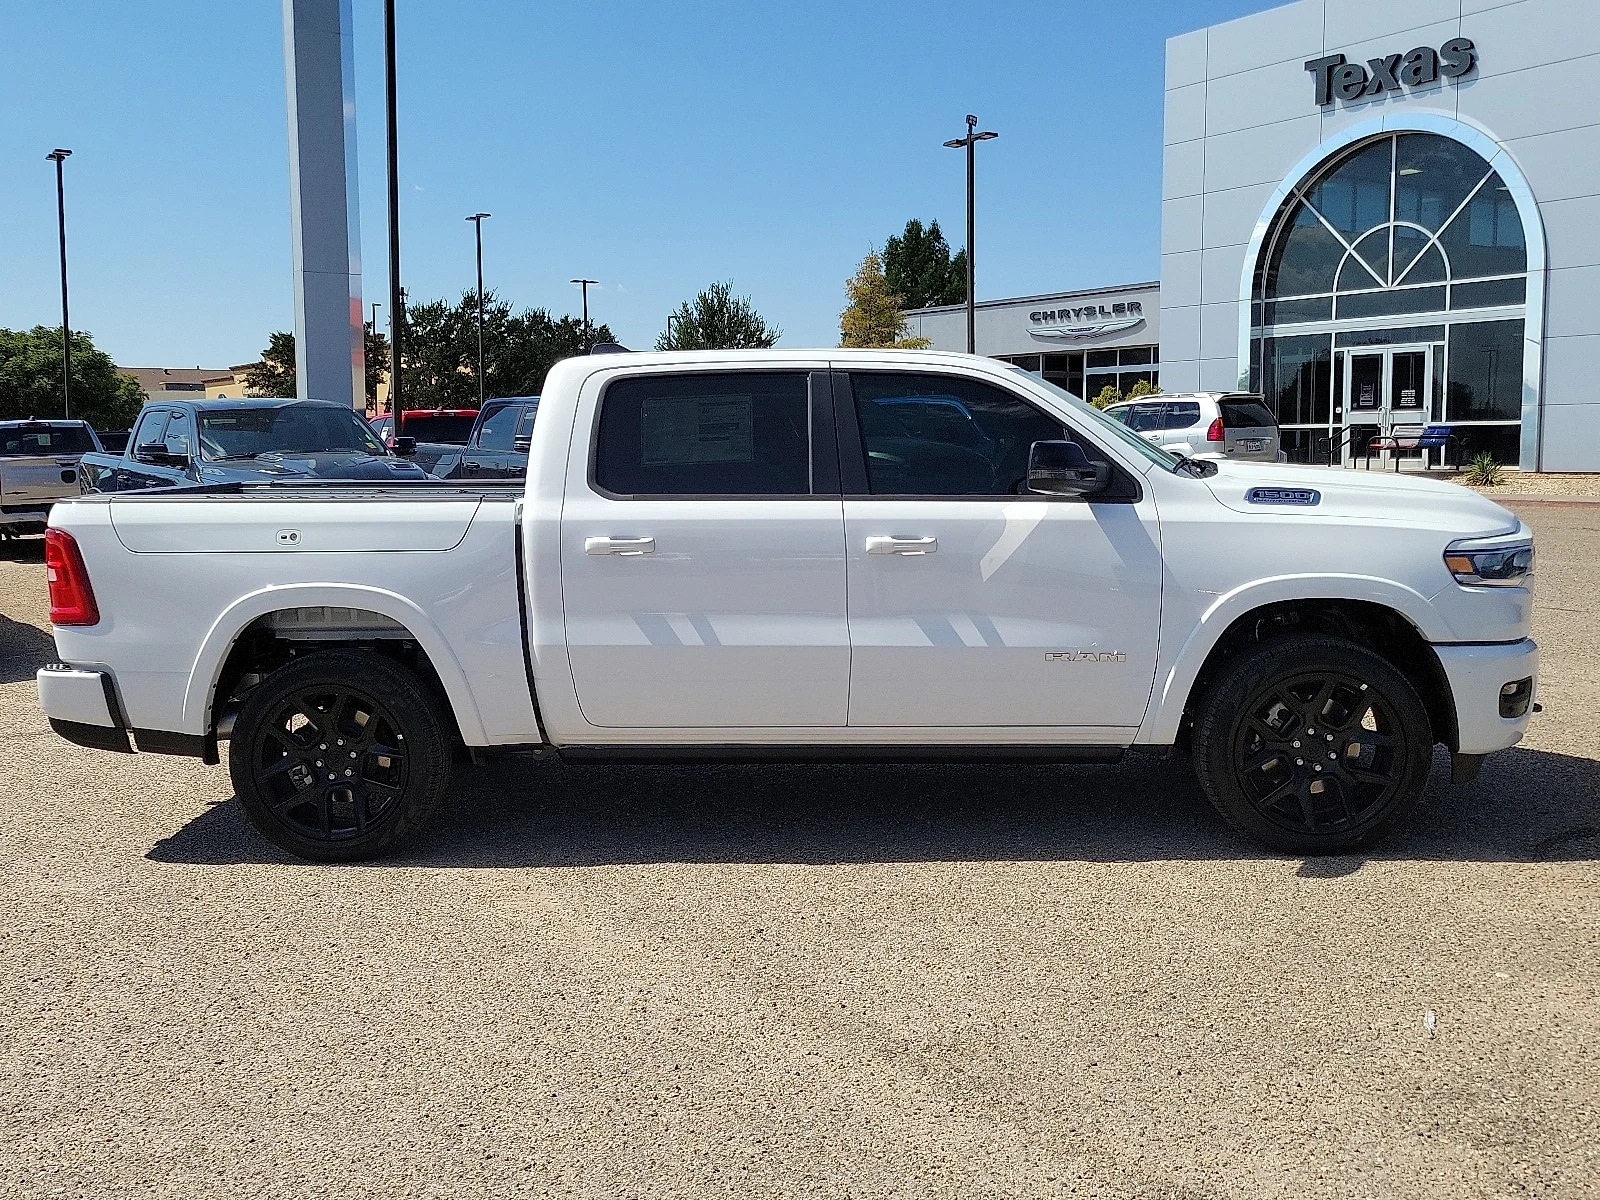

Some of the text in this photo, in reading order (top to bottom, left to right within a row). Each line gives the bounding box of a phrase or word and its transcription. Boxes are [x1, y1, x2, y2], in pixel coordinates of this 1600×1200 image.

[1304, 38, 1475, 106] Texas
[1029, 302, 1142, 321] CHRYSLER
[1257, 491, 1310, 499] 1500
[1045, 651, 1126, 662] RAM
